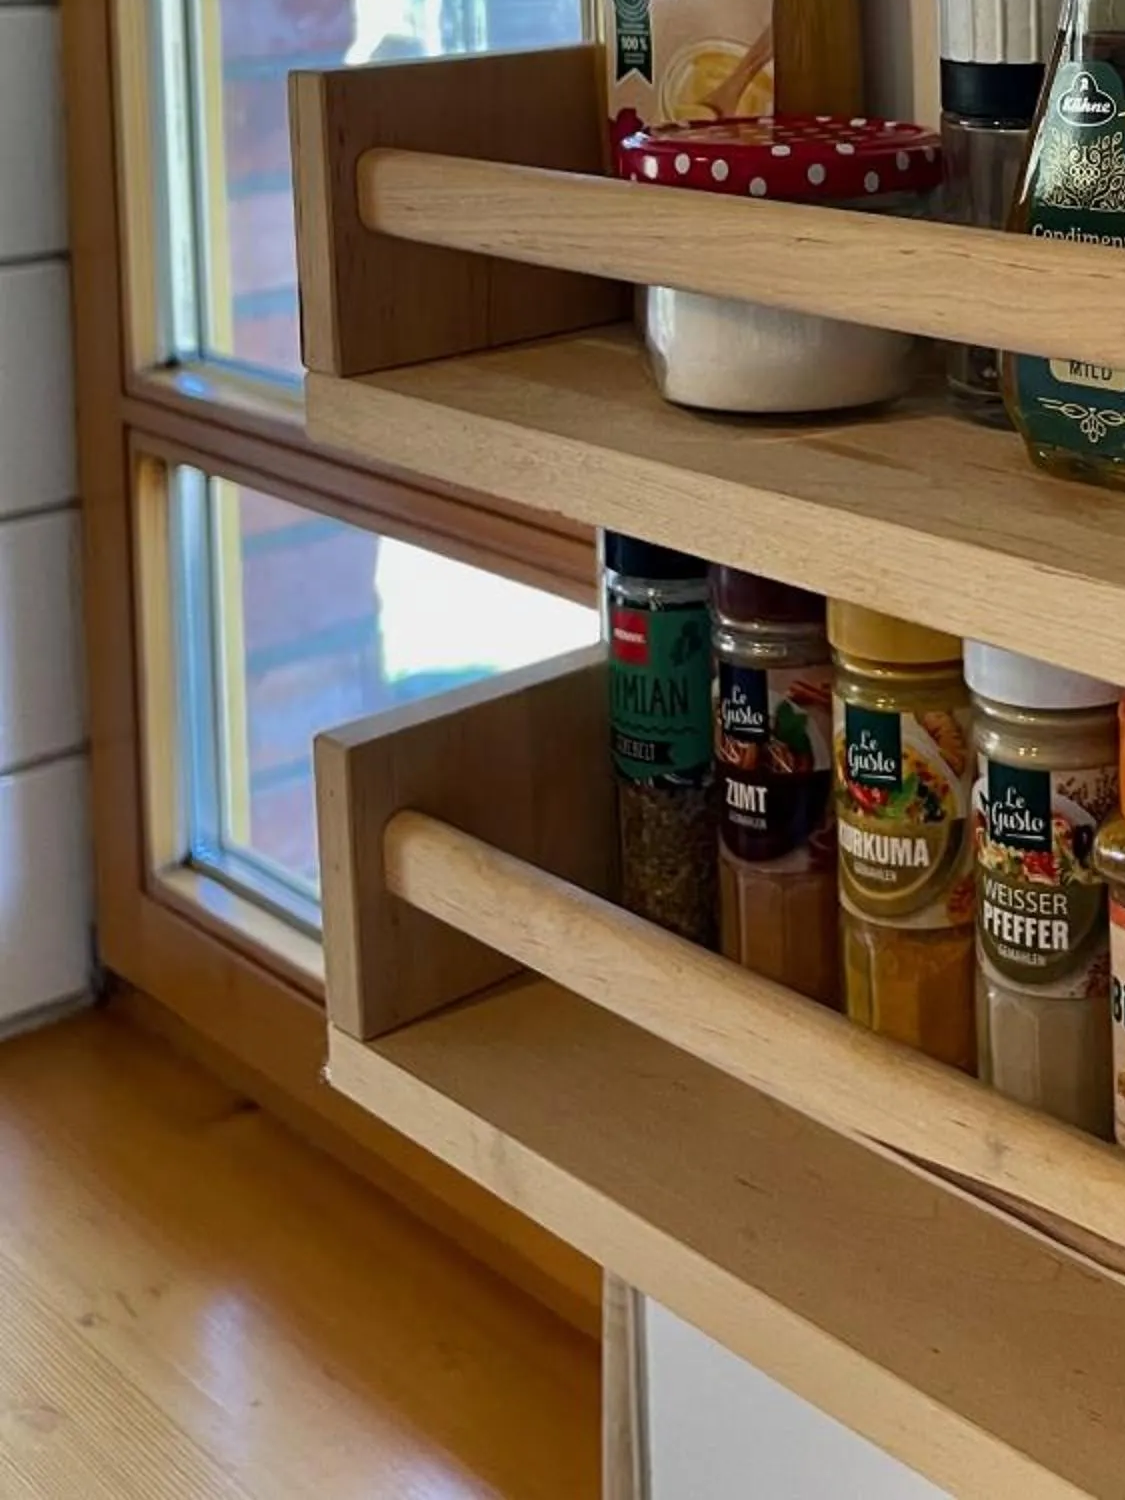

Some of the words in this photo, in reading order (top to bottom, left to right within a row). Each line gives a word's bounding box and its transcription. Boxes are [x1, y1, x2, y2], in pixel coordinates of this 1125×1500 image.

[613, 673, 690, 719] MIAN
[731, 685, 748, 705] Le
[721, 698, 764, 735] Gusto
[859, 729, 878, 751] Le
[847, 742, 896, 776] Gusto
[724, 776, 769, 814] ZIMT
[1005, 785, 1026, 809] Le
[991, 801, 1045, 836] Gusto
[983, 875, 1069, 916] WEISSER
[983, 900, 1070, 951] PFEFFER
